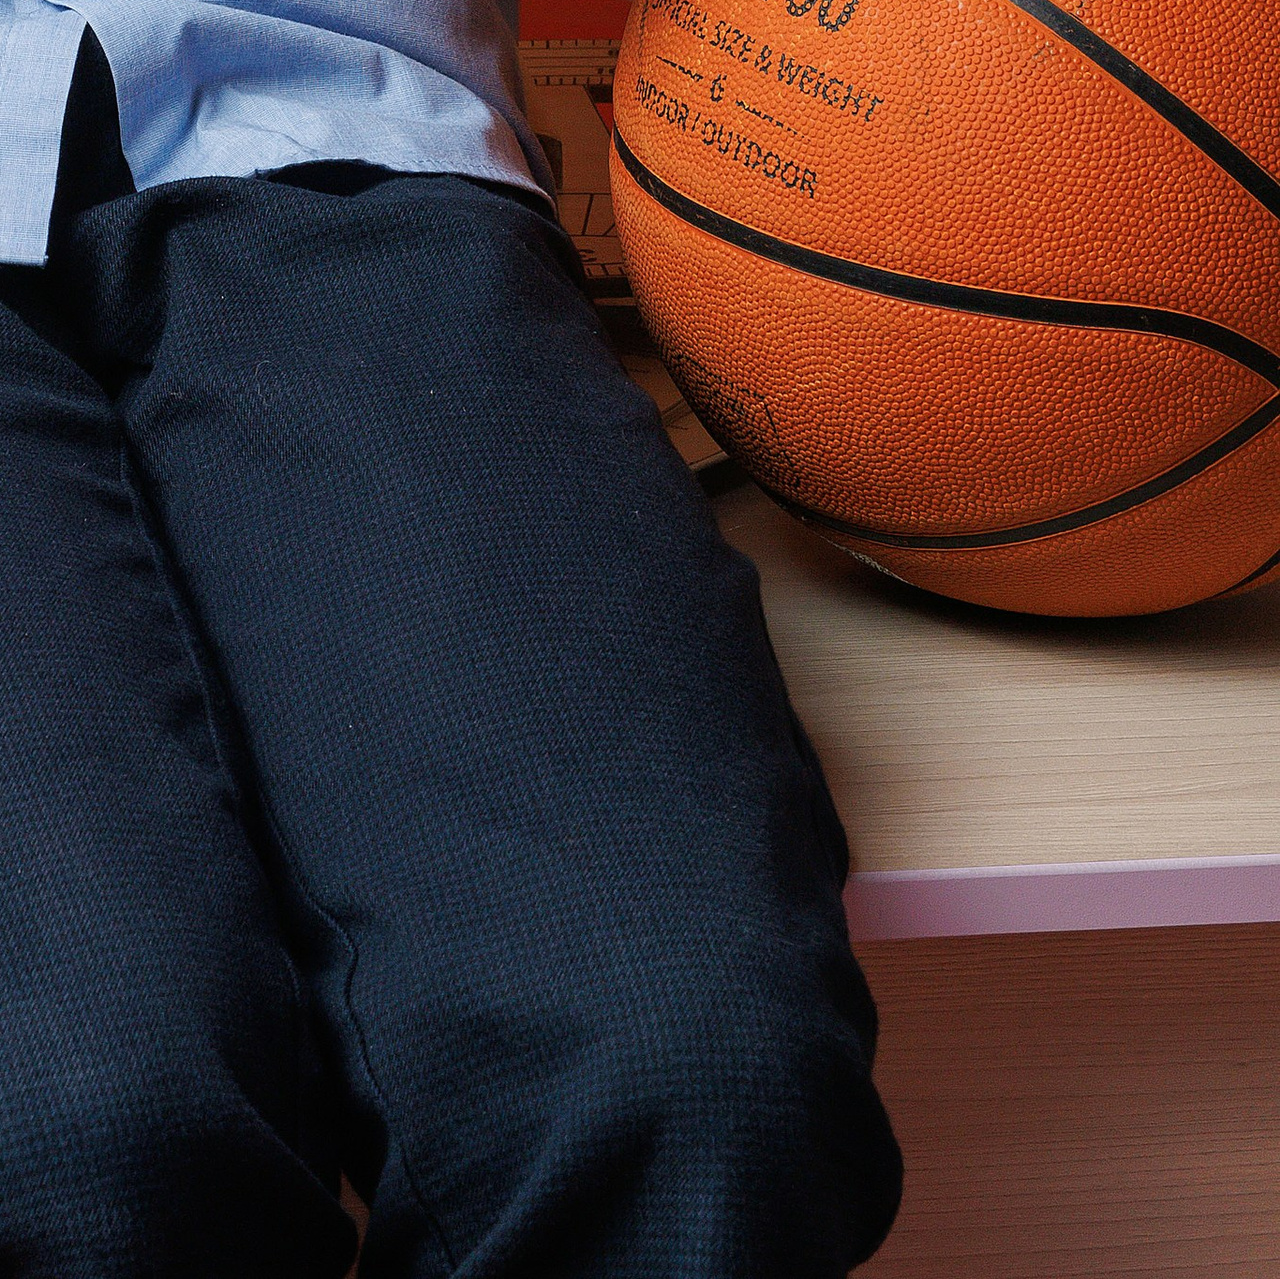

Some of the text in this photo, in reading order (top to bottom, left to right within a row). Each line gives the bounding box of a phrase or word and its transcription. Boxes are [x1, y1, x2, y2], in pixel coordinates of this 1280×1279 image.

[709, 20, 756, 63] SIZE
[777, 53, 884, 123] WEIGHT
[709, 74, 728, 103] 6
